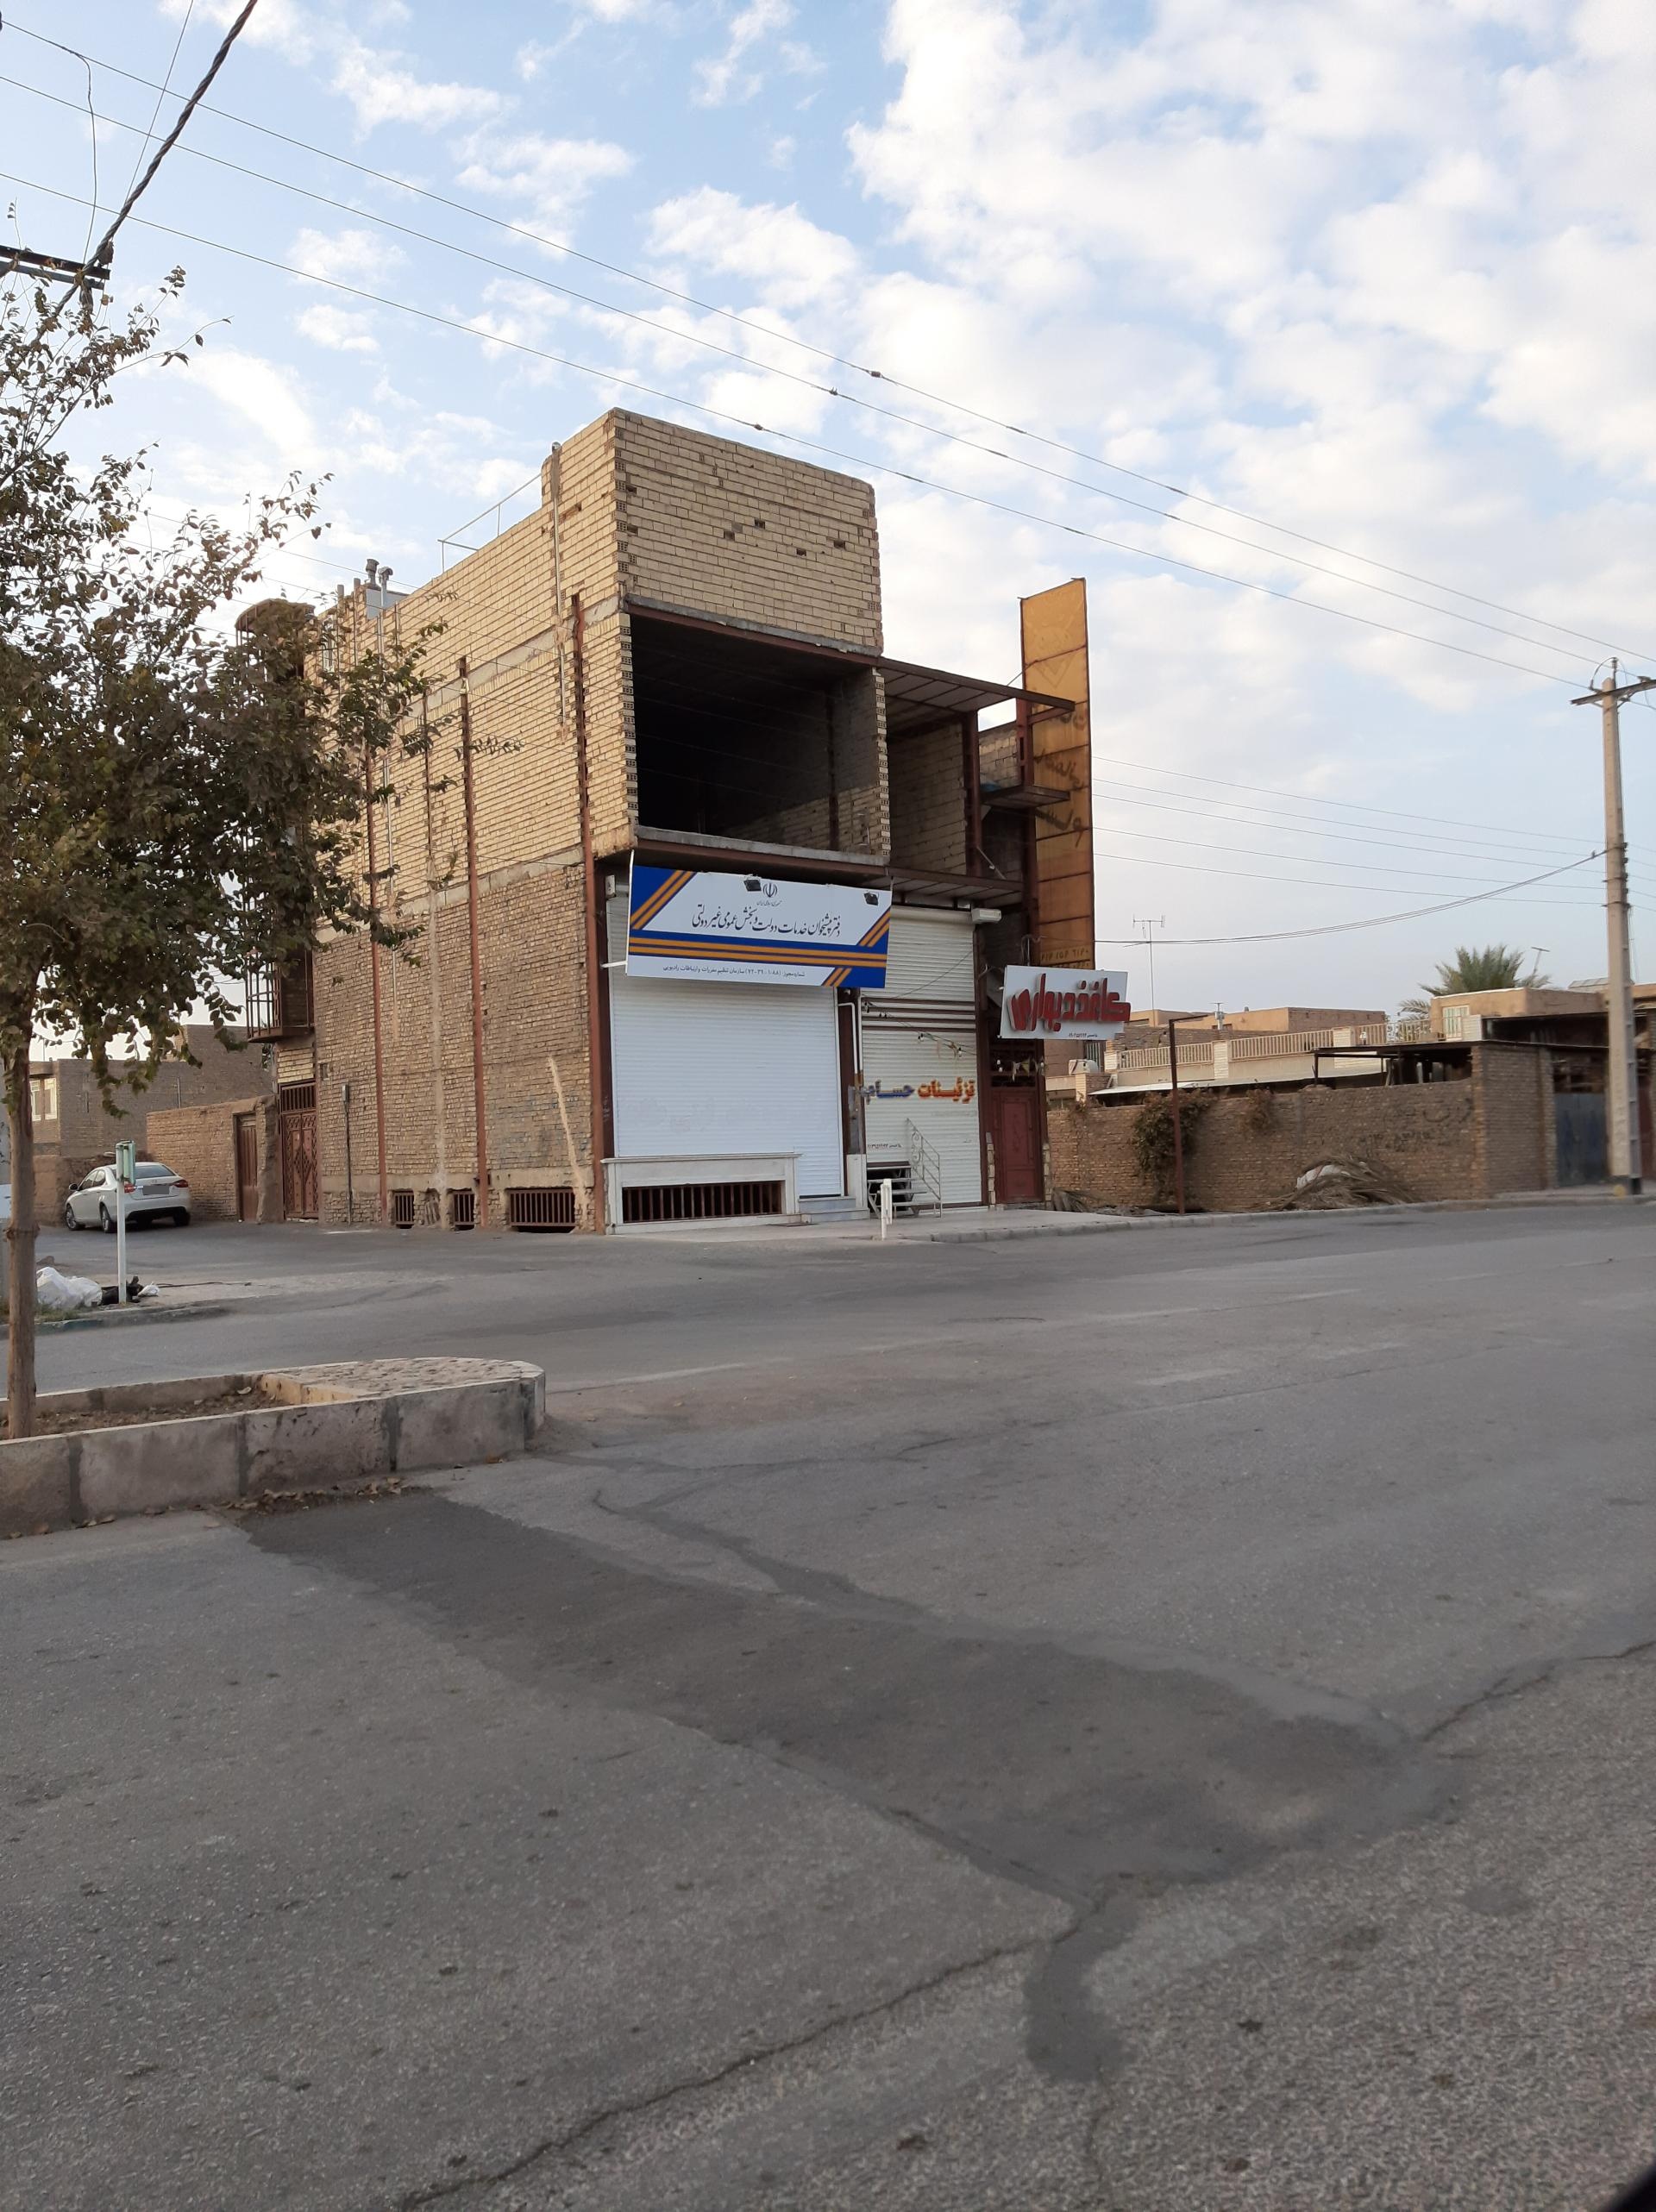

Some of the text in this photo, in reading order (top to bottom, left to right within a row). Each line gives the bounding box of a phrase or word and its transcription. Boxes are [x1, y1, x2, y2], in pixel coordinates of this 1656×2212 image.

[692, 904, 708, 928] دولتی
[706, 905, 722, 929] غیر
[718, 912, 737, 930] عمومی
[735, 906, 758, 931] بخش
[752, 918, 777, 932] دولت
[778, 921, 807, 935] خدمات
[807, 912, 833, 936] پیشخوان
[829, 915, 842, 937] دفتر
[1007, 973, 1132, 1032] کاغذ دیواری
